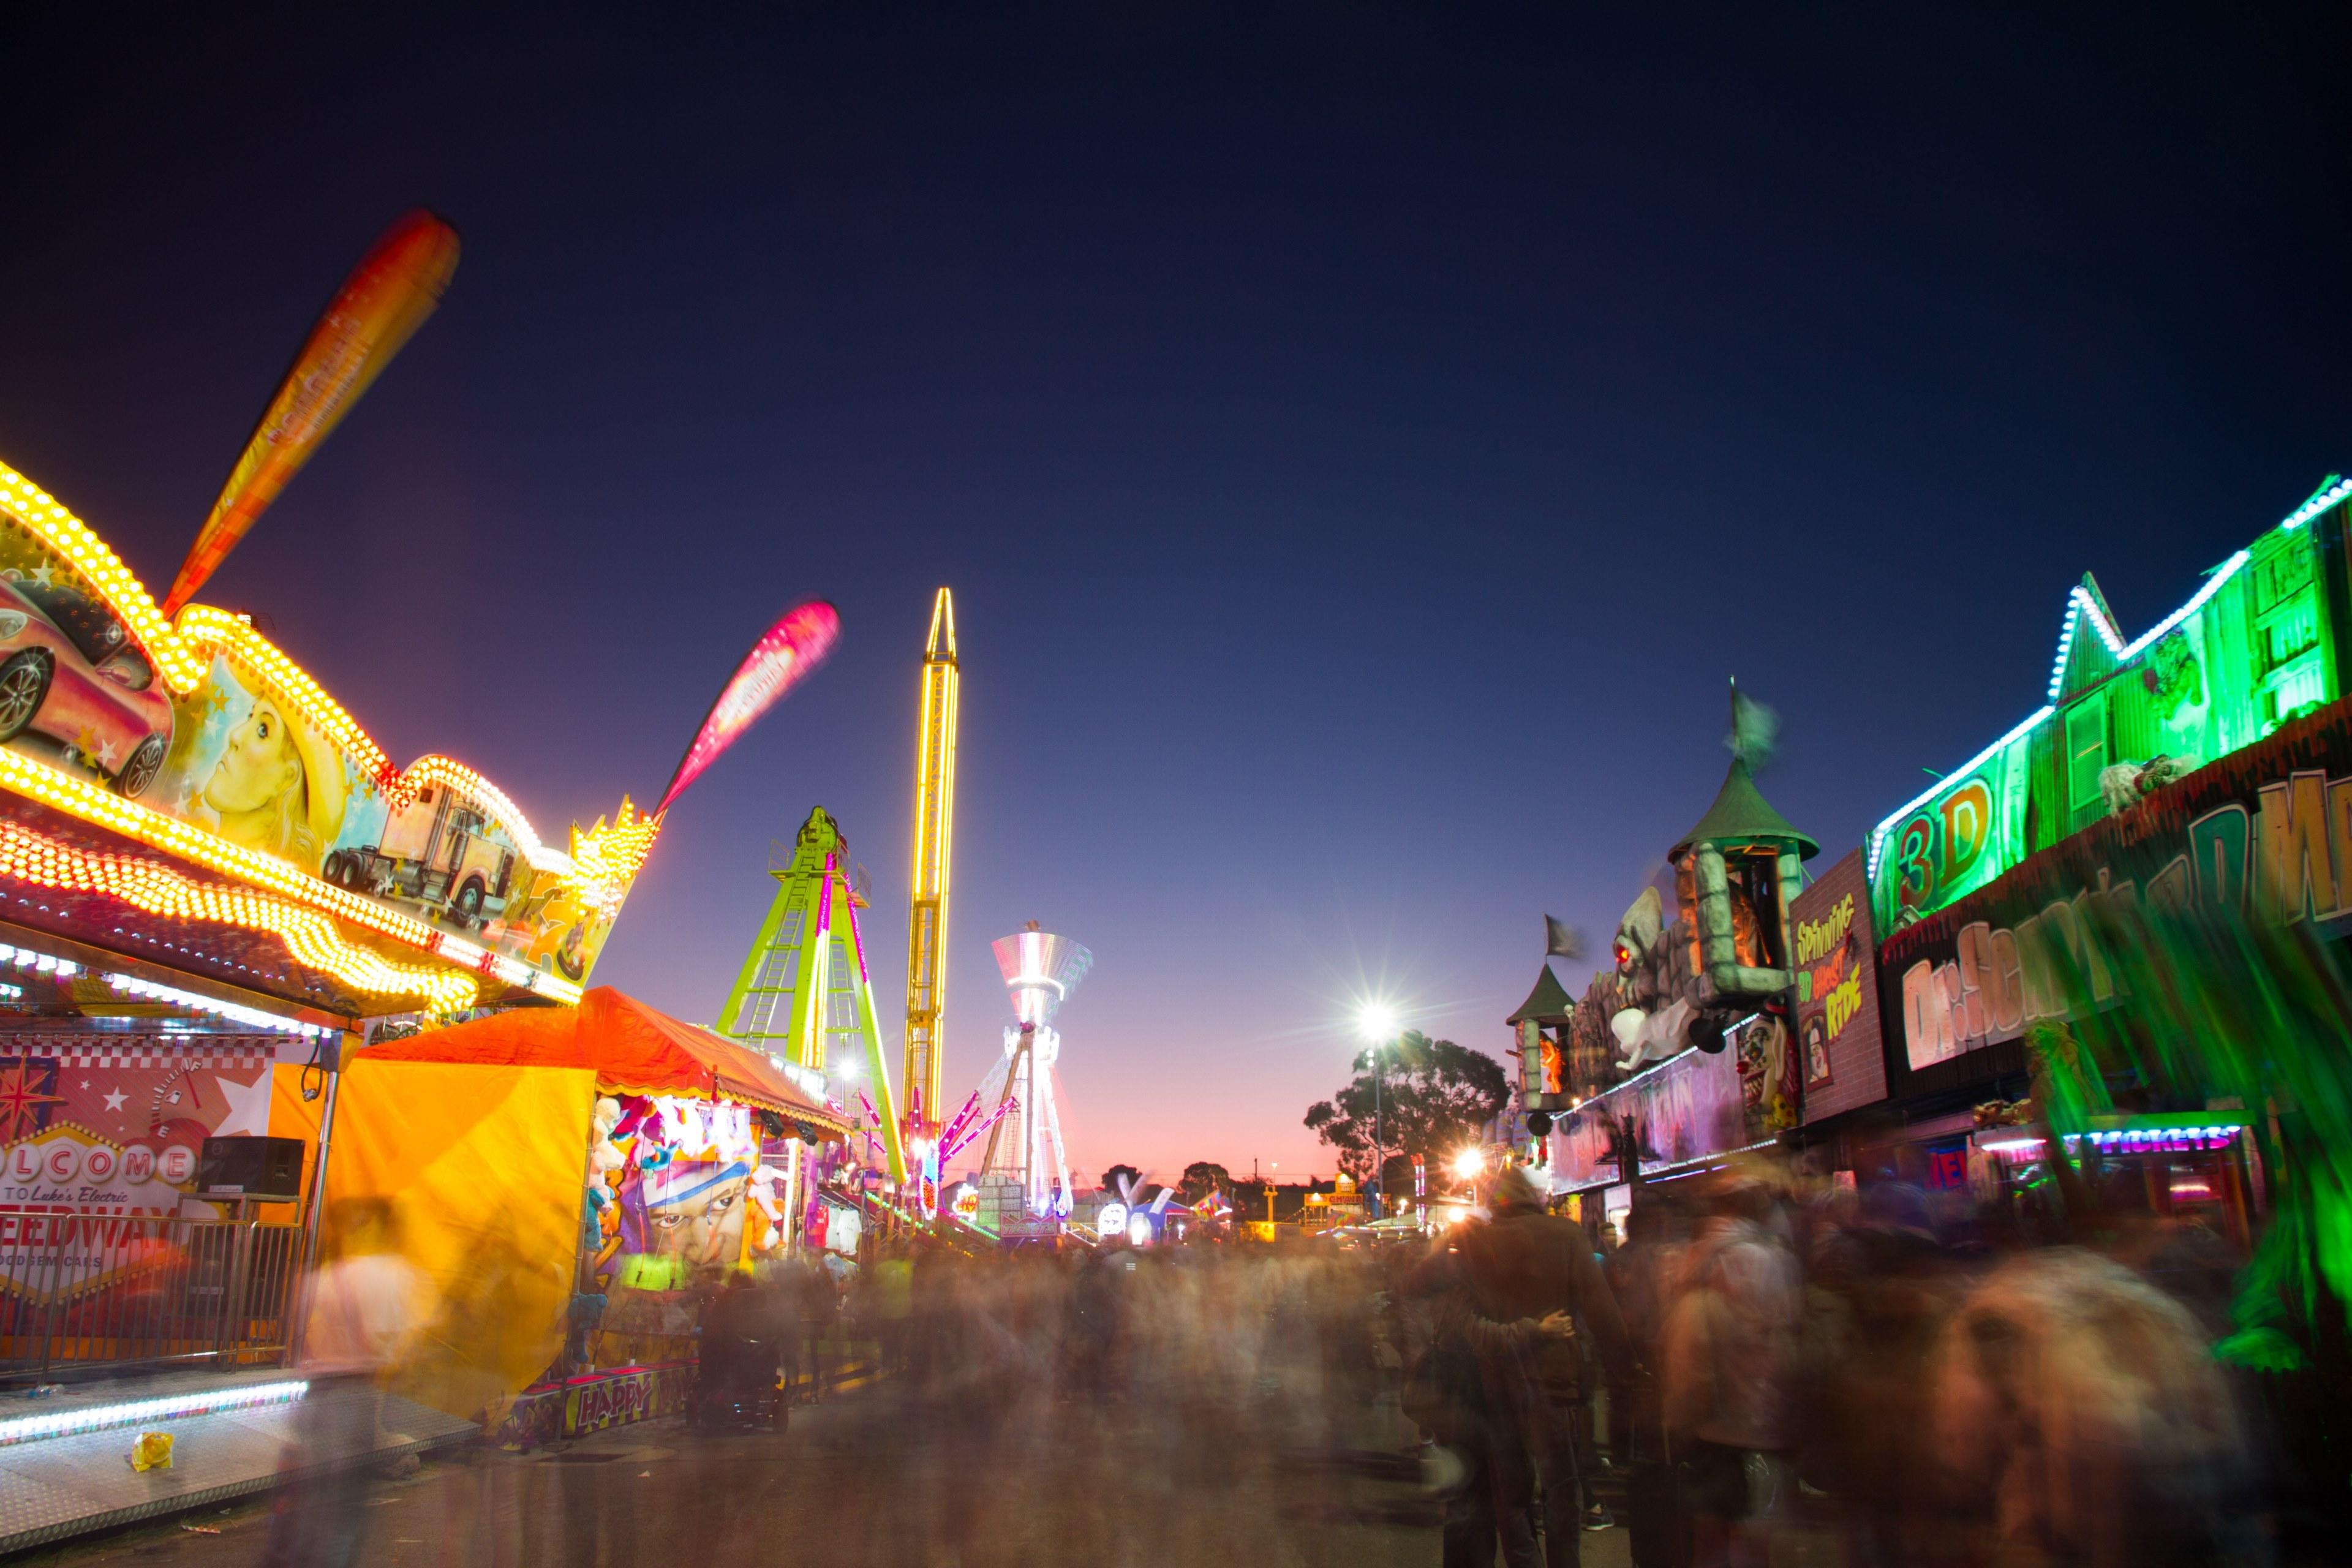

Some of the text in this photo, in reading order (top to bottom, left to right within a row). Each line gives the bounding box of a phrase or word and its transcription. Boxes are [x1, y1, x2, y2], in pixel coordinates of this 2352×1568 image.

[1899, 778, 1992, 910] 3D
[1798, 946, 1846, 1002] 3D GHOST
[5, 1186, 129, 1202] TO Luke's Electric
[578, 1380, 651, 1427] HAPPY
